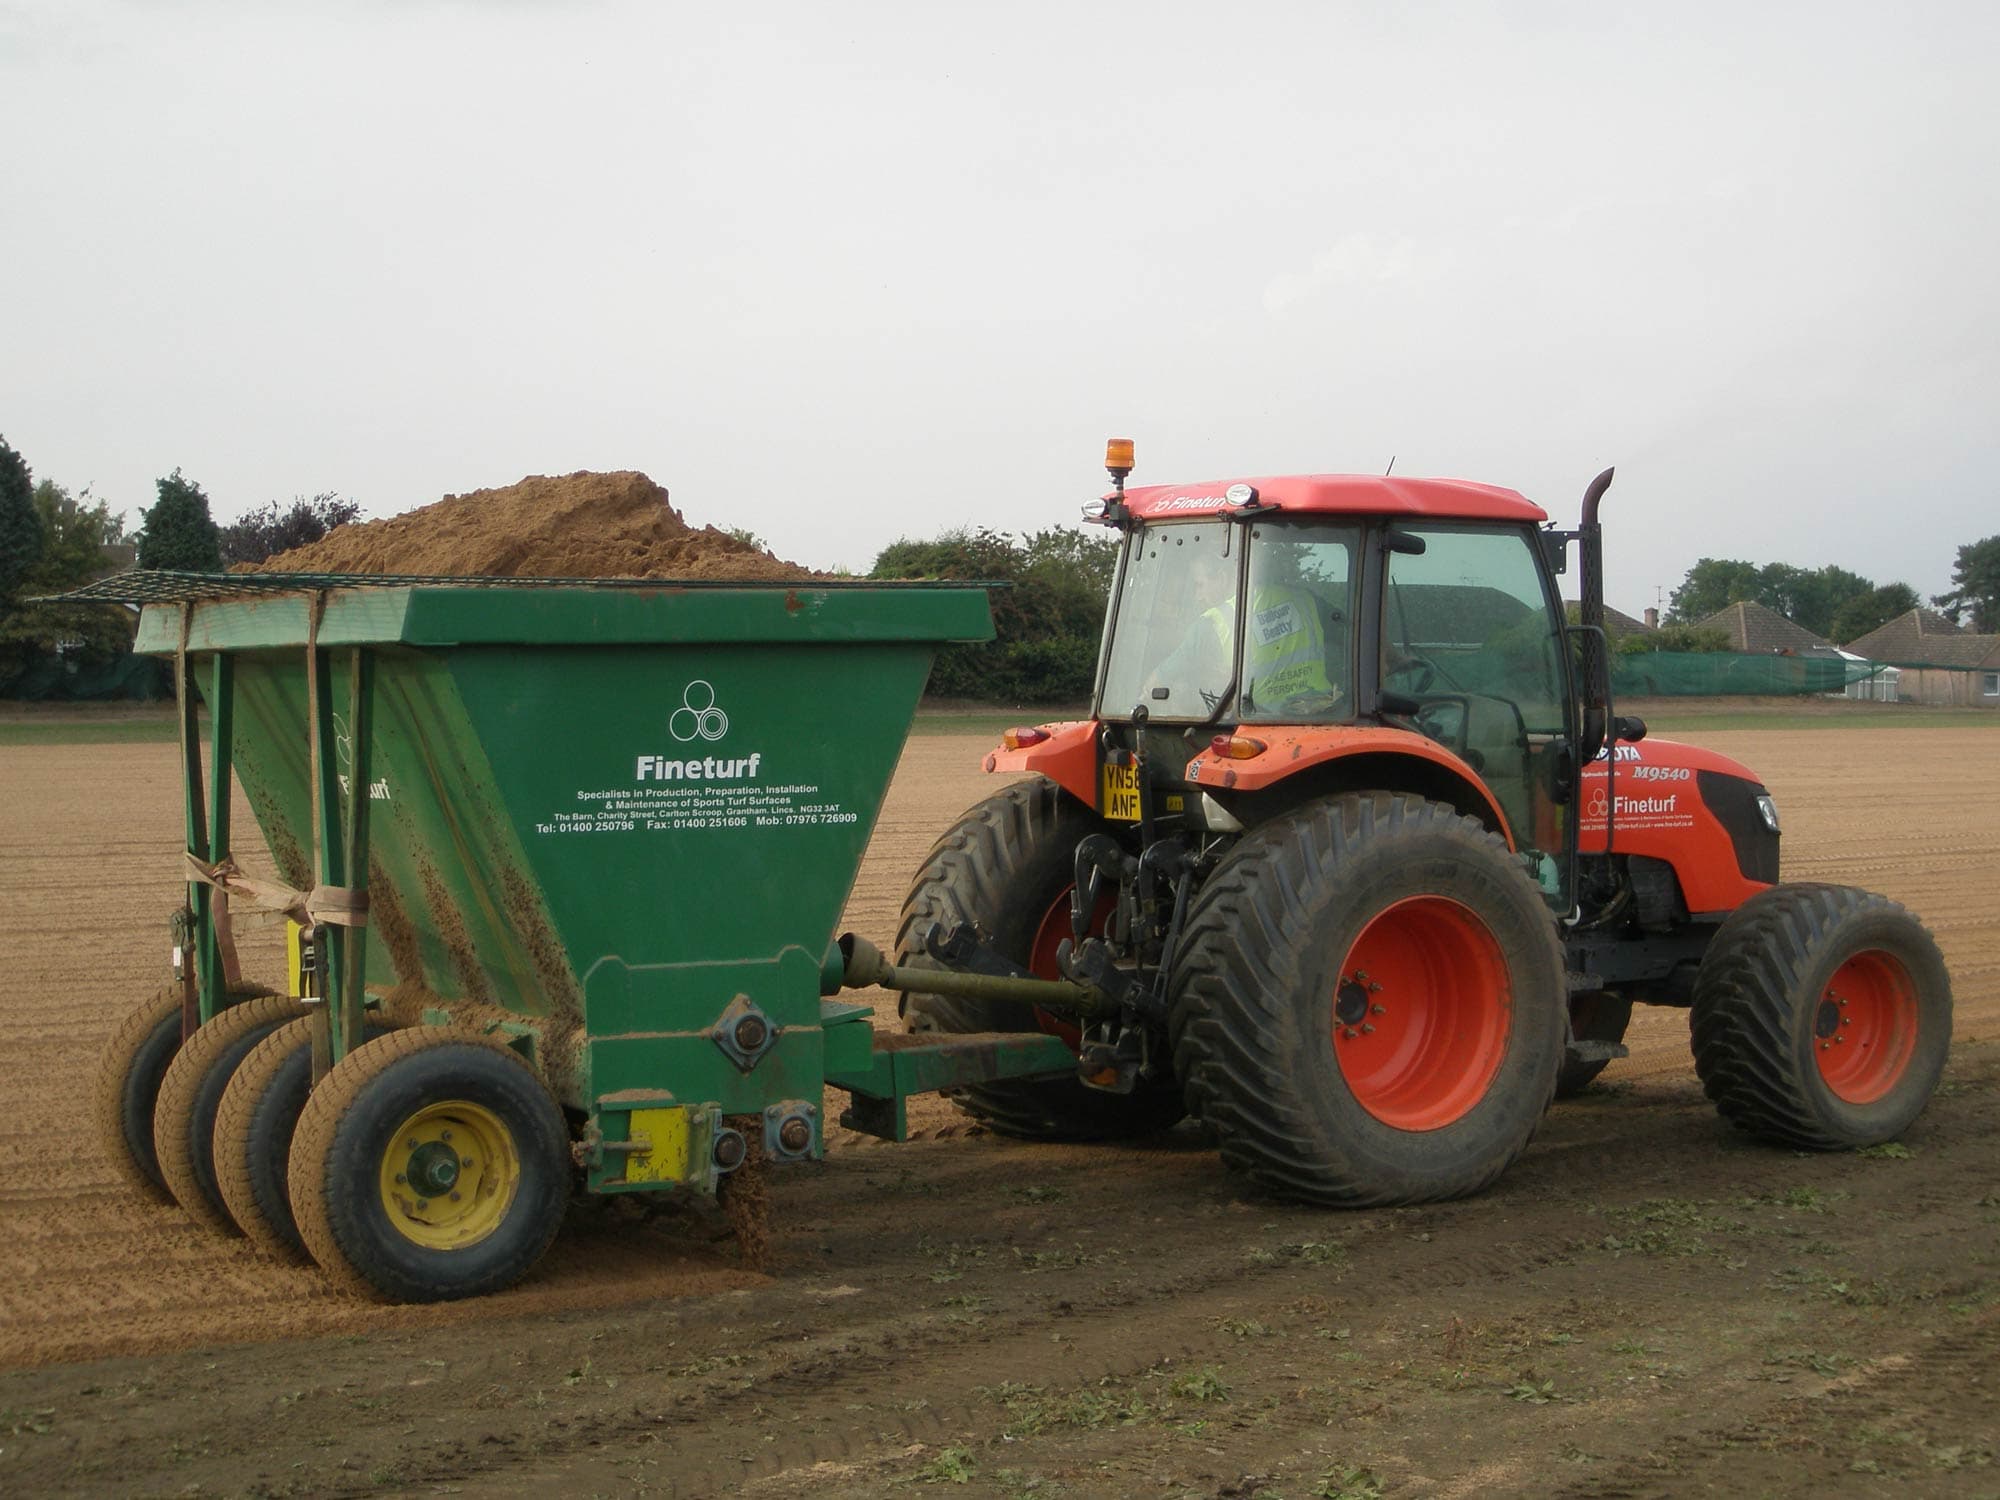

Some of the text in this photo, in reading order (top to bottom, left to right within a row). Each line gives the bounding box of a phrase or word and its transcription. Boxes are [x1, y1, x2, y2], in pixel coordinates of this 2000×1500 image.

[1168, 496, 1226, 510] Finetur
[637, 754, 760, 780] Fineturf
[1632, 766, 1690, 781] M9540
[577, 784, 818, 801] Specialists in Production, Preparation, Installation
[605, 796, 791, 810] & Maintenance of Sports Turf Surfaces
[1112, 793, 1138, 817] ANF
[1614, 795, 1676, 813] Fineturf
[555, 813, 570, 821] The
[597, 811, 628, 821] Charity
[659, 809, 690, 818] Carlton
[800, 805, 823, 813] NG32
[825, 804, 840, 812] 3AT
[756, 813, 858, 826] Mob: 07976 726909
[536, 820, 635, 834] Tel: 01400 250796
[647, 817, 748, 830] Fax: 01400 251606
